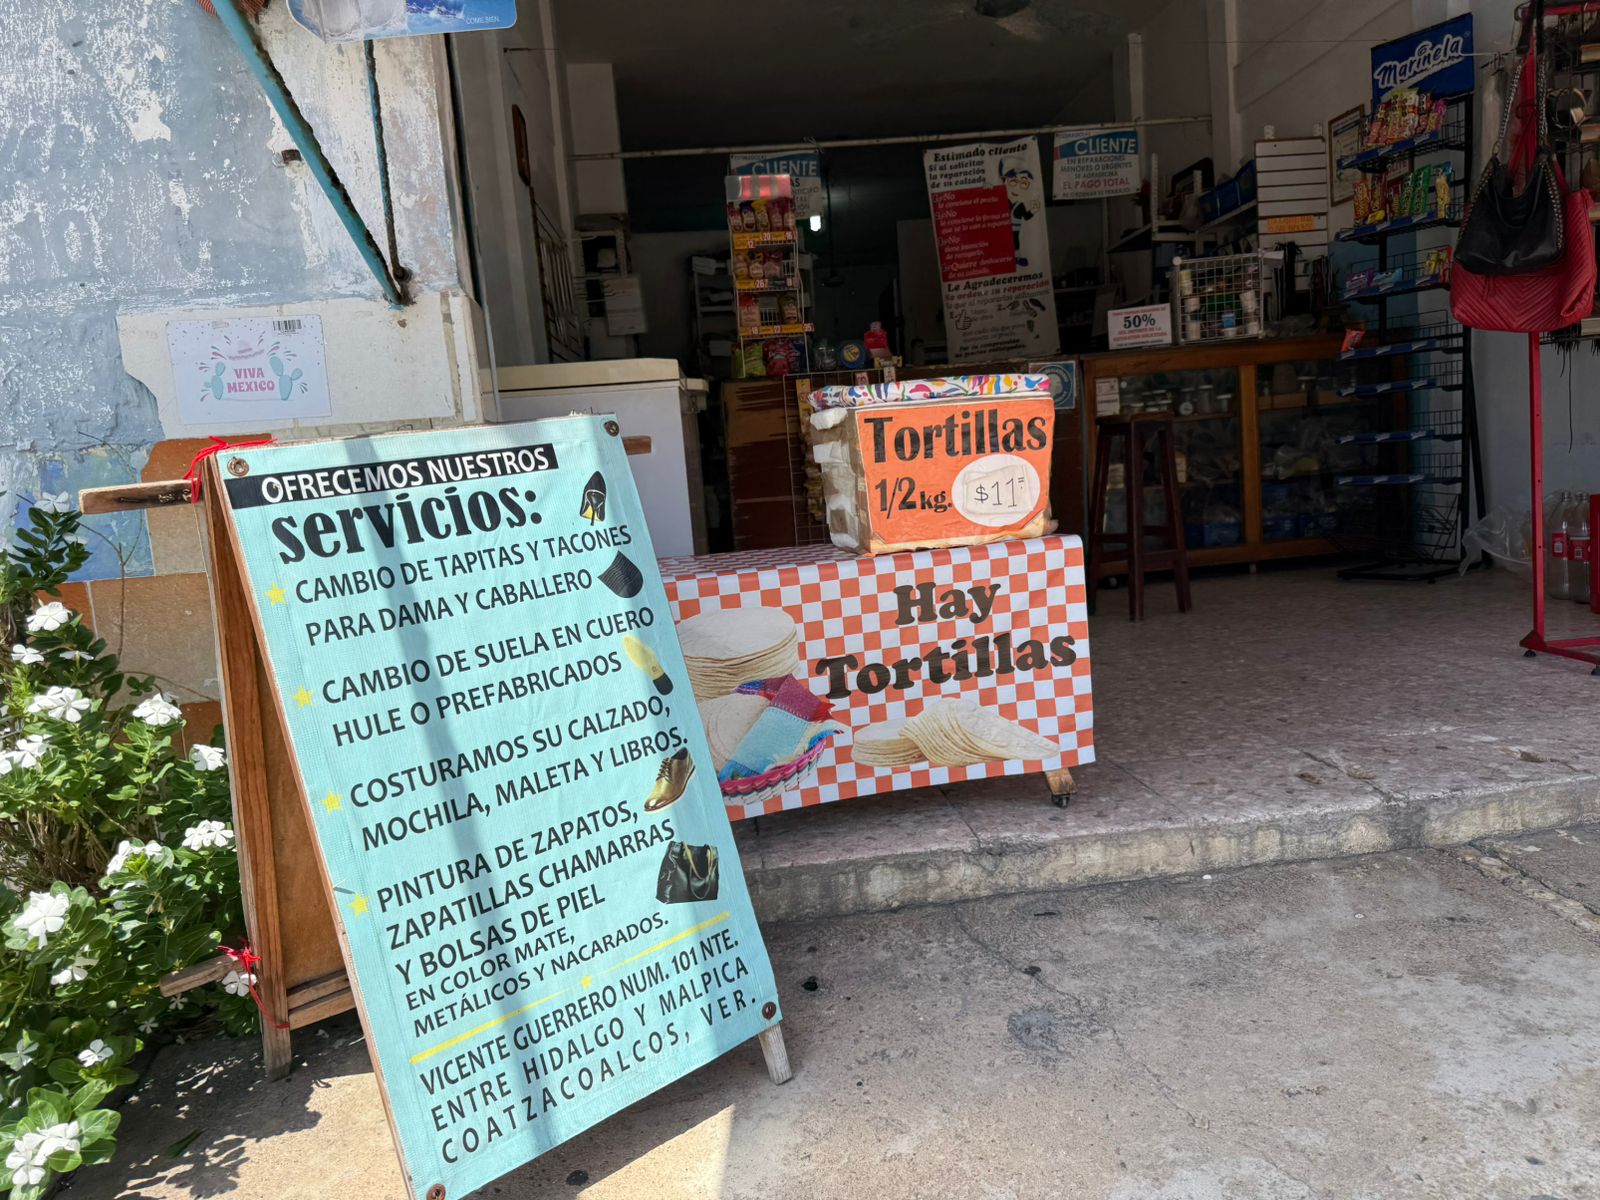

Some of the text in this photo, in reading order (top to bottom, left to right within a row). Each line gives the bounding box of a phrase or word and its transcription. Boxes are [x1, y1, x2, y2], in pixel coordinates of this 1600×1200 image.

[1375, 35, 1464, 88] Marinela
[751, 160, 818, 176] CLIENTE
[929, 168, 986, 182] la reparación
[934, 142, 1027, 162] Estimado cliente
[938, 163, 947, 171] al
[1074, 137, 1137, 154] CLIENTE
[930, 181, 940, 189] de
[1063, 176, 1130, 190] EL PAGO TOTAL
[948, 282, 960, 292] Le
[962, 272, 1044, 290] Agradeceremos
[1124, 314, 1156, 328] 50%
[226, 380, 276, 394] MEXICO
[233, 368, 265, 380] VIVA
[864, 408, 1047, 463] Tortillas
[261, 446, 550, 503] OFRECEMOS NUESTROS
[875, 476, 952, 519] 1/2 kg.
[271, 485, 543, 565] servicios:
[295, 525, 632, 604] CAMBIO DE TAPITAS Y TACONES
[305, 569, 592, 646] PARA DAMA Y CABALLERO
[892, 582, 1002, 626] Hay
[321, 606, 654, 704] CAMBIO DE SUELA EN CUERO
[815, 632, 1078, 700] Tortillas
[332, 651, 622, 747] HULE O PREFABRICADOS
[349, 695, 672, 808] COSTURAMOS SU CALZADO,
[362, 726, 690, 852] MOCHILA, MALETA Y LIBROS.
[377, 800, 640, 914] PINTURA DE ZAPATOS,
[386, 818, 676, 951] ZAPATILLAS CHAMARRAS
[395, 884, 606, 987] Y BOLSAS DE PIEL
[406, 926, 576, 1011] EN COLOR MATE,
[414, 912, 670, 1038] METÁLICOS Y NACARADOS.
[420, 928, 740, 1096] VICENTE GUERRERO NUM. 101 NTE.
[430, 956, 749, 1132] ENTRE HIDALGO Y MALPICA
[442, 988, 756, 1164] COATZACOALCOS, VER.
